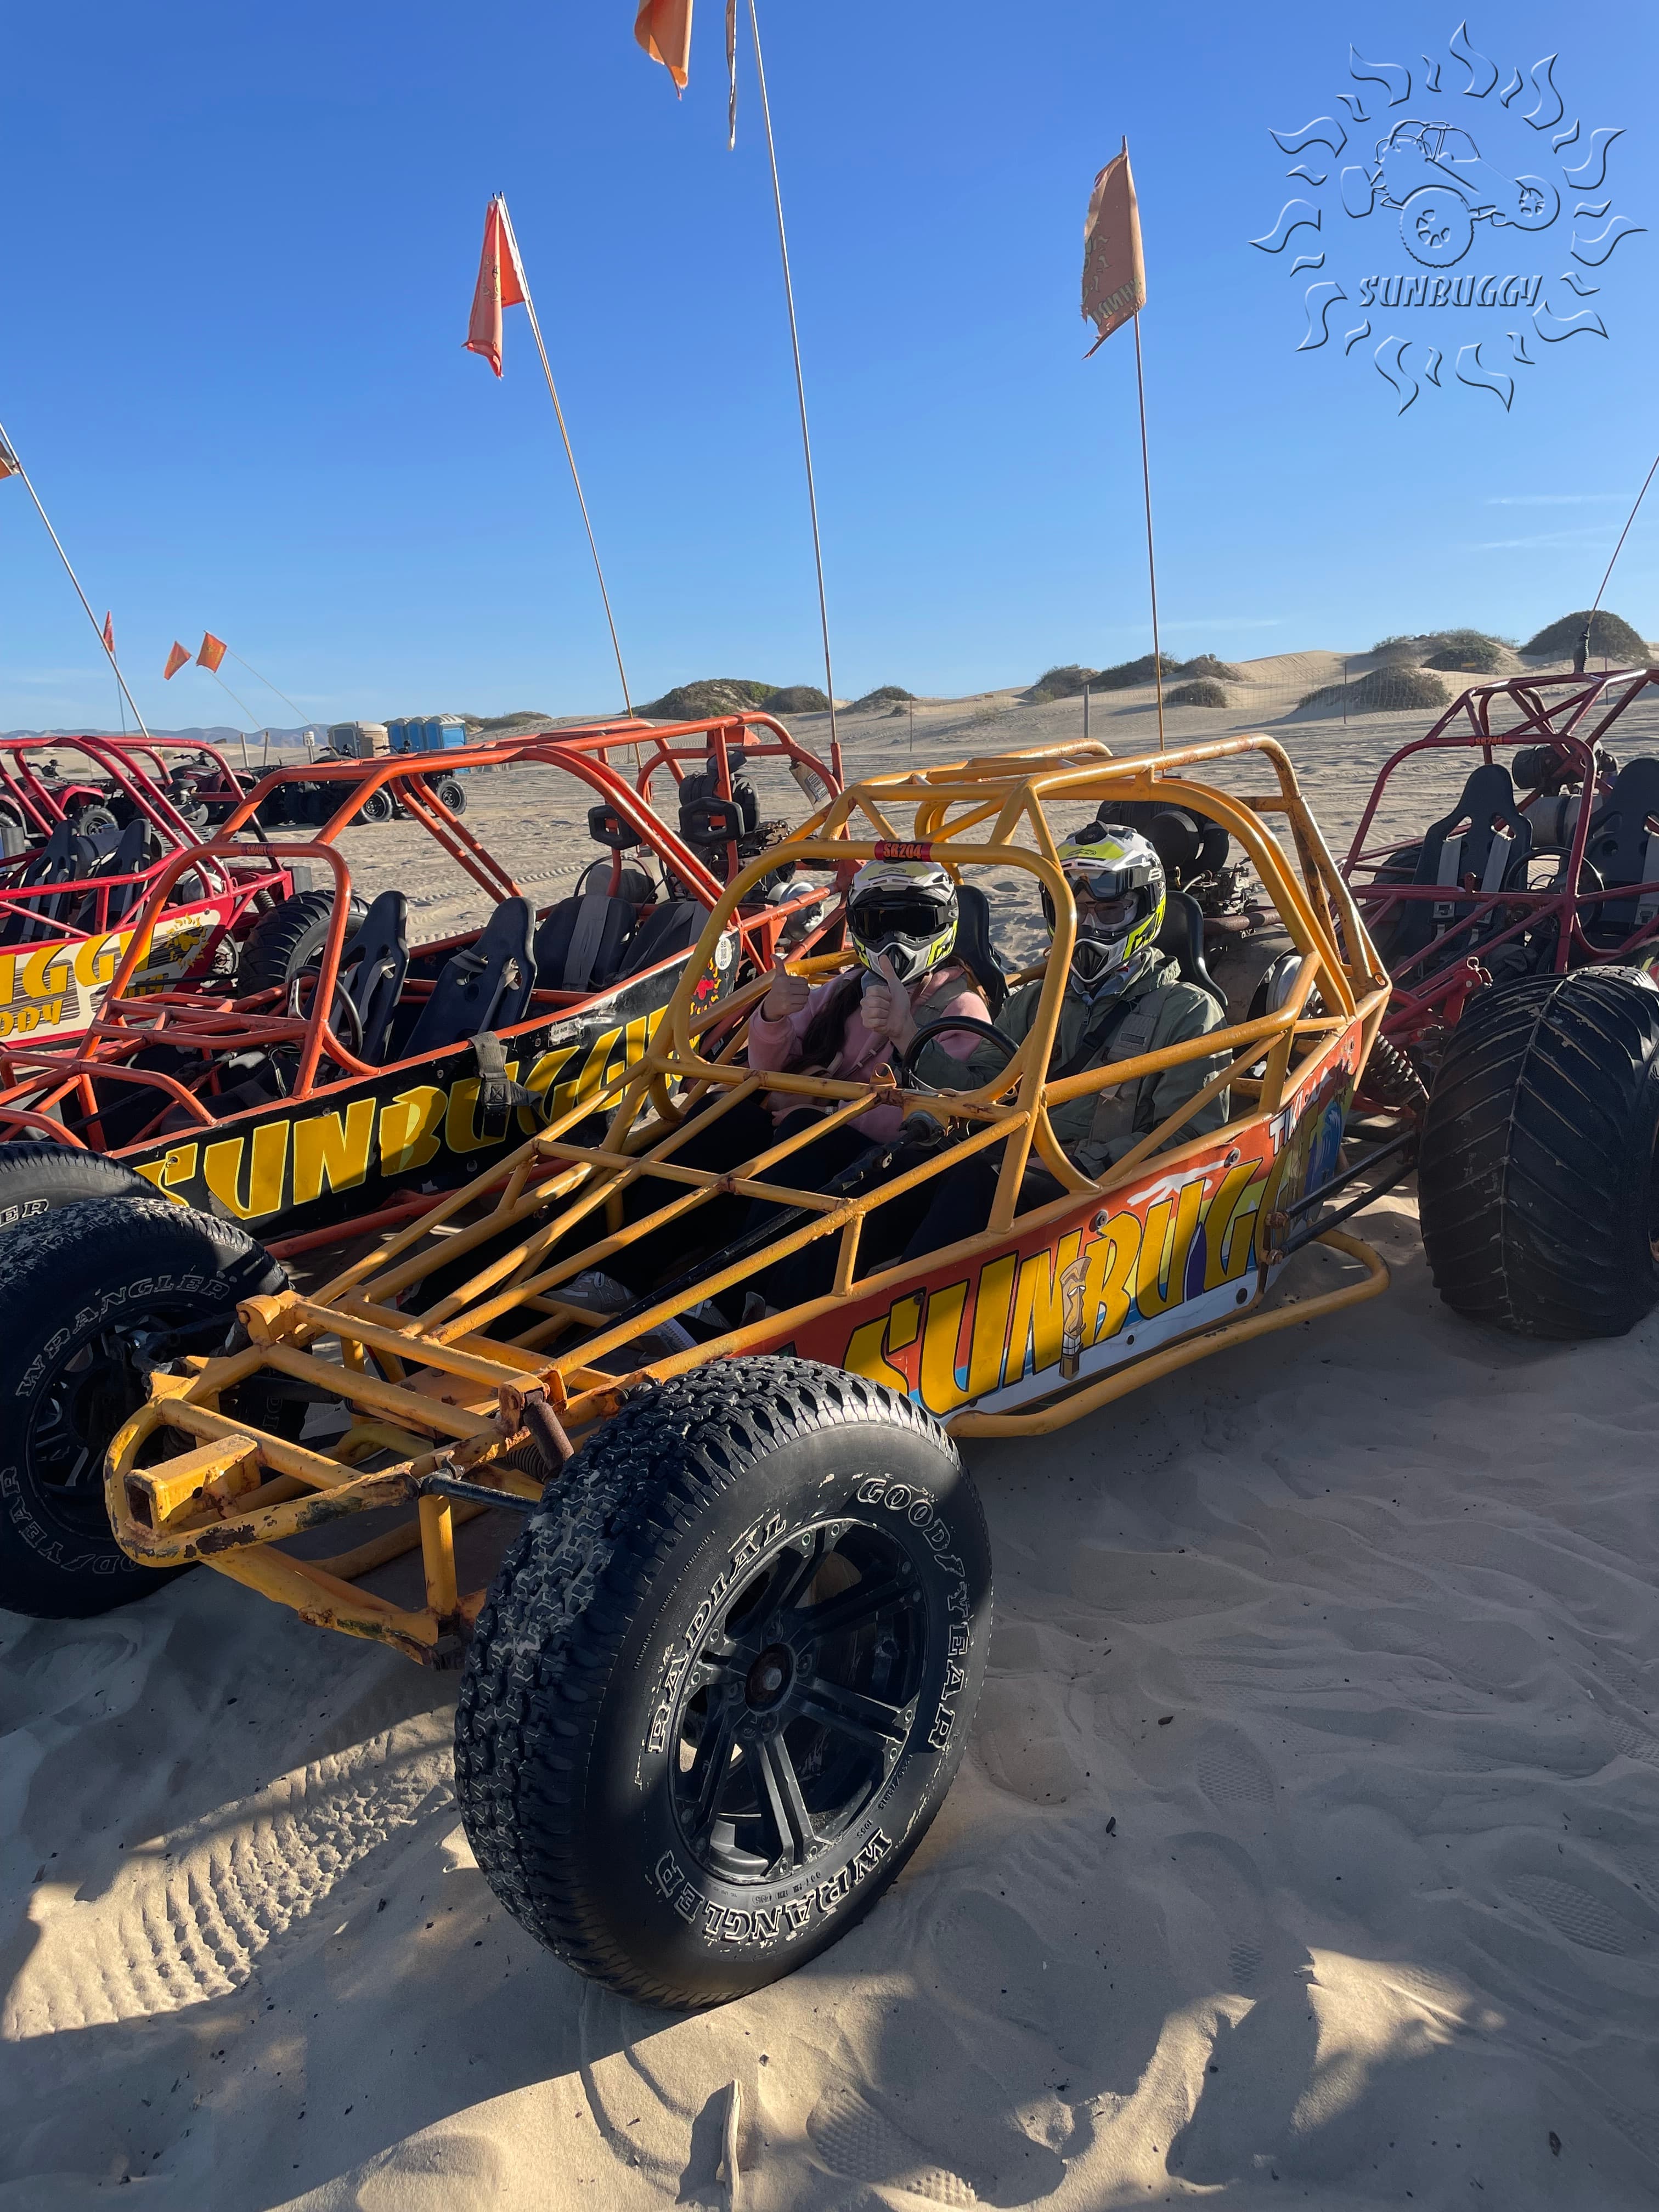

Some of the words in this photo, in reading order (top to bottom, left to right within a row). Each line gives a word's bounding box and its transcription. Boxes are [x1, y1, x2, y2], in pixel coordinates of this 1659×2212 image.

[883, 843, 922, 859] SB204
[15, 1274, 230, 1397] WRANGLER
[646, 1514, 788, 1754] RADIAL
[855, 1477, 970, 1750] GOODYEAR
[657, 1827, 893, 1943] WRANGLER
